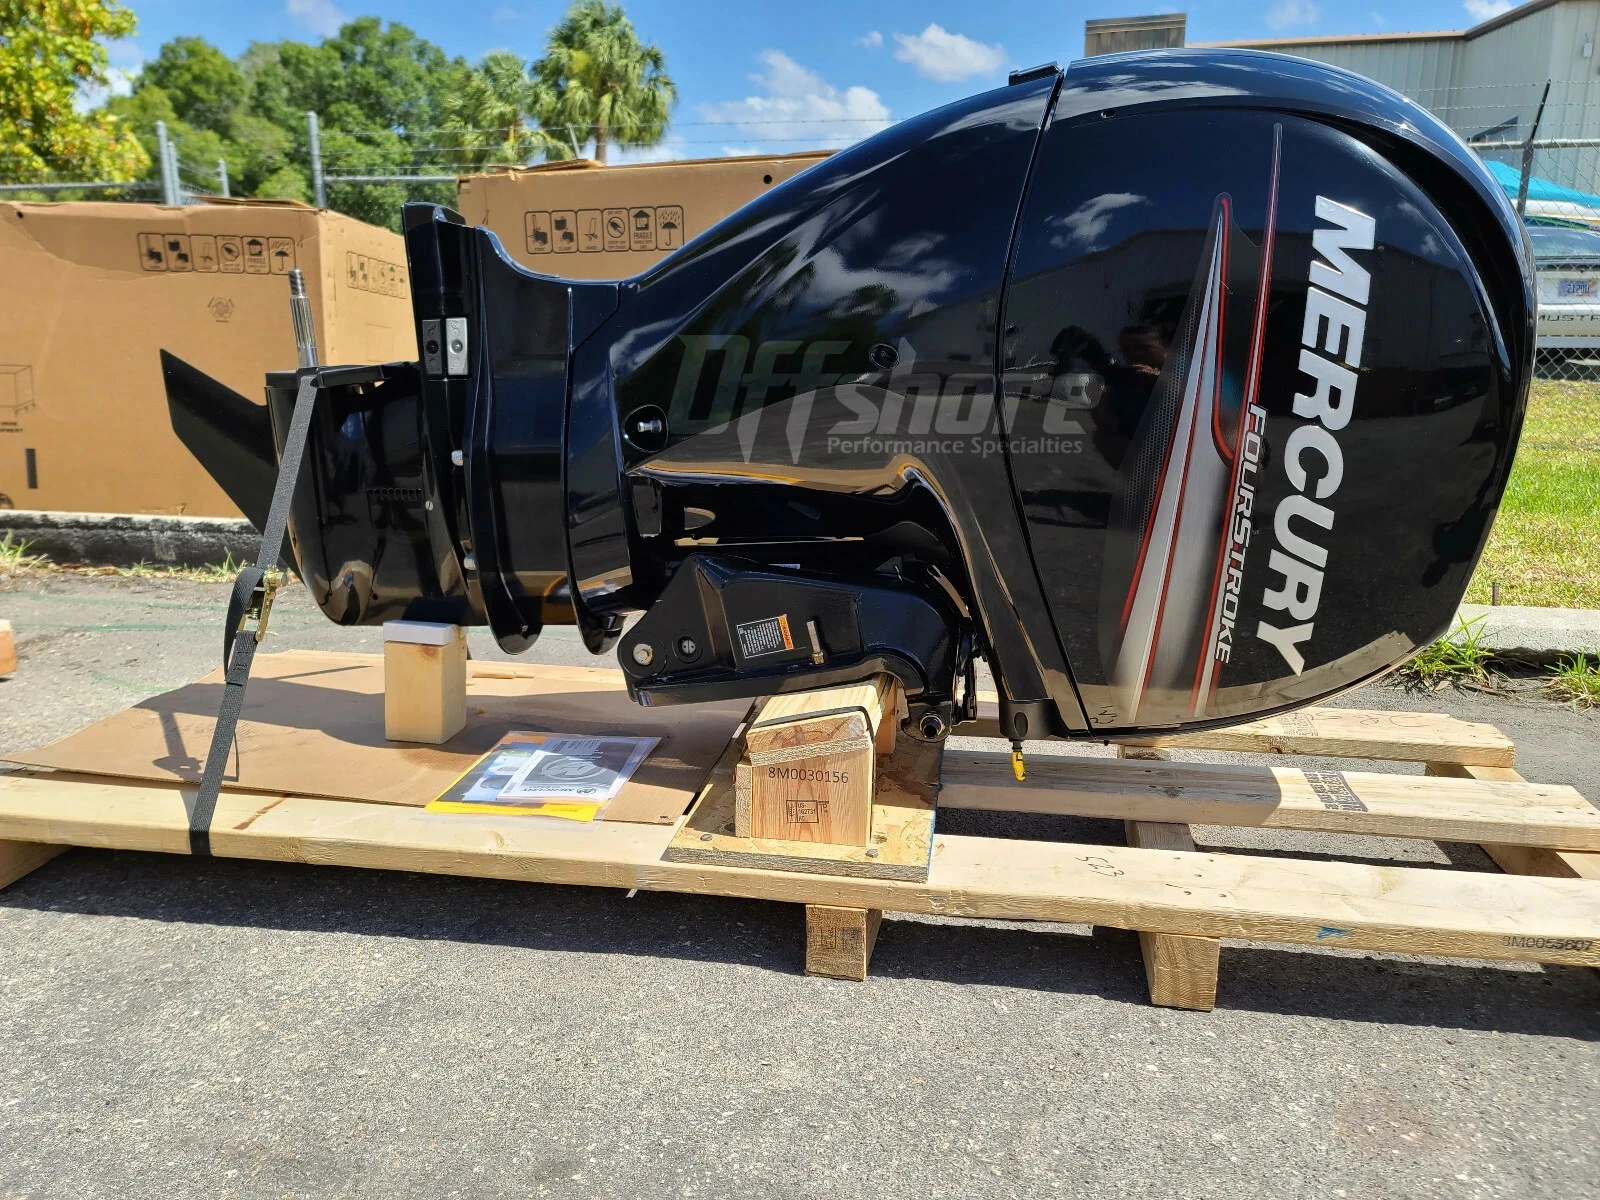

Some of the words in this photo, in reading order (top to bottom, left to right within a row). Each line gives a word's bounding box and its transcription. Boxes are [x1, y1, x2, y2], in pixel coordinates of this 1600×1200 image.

[1214, 402, 1268, 666] FOURSTROKE
[1256, 195, 1376, 677] MERCURY
[768, 767, 849, 783] 8M0030156
